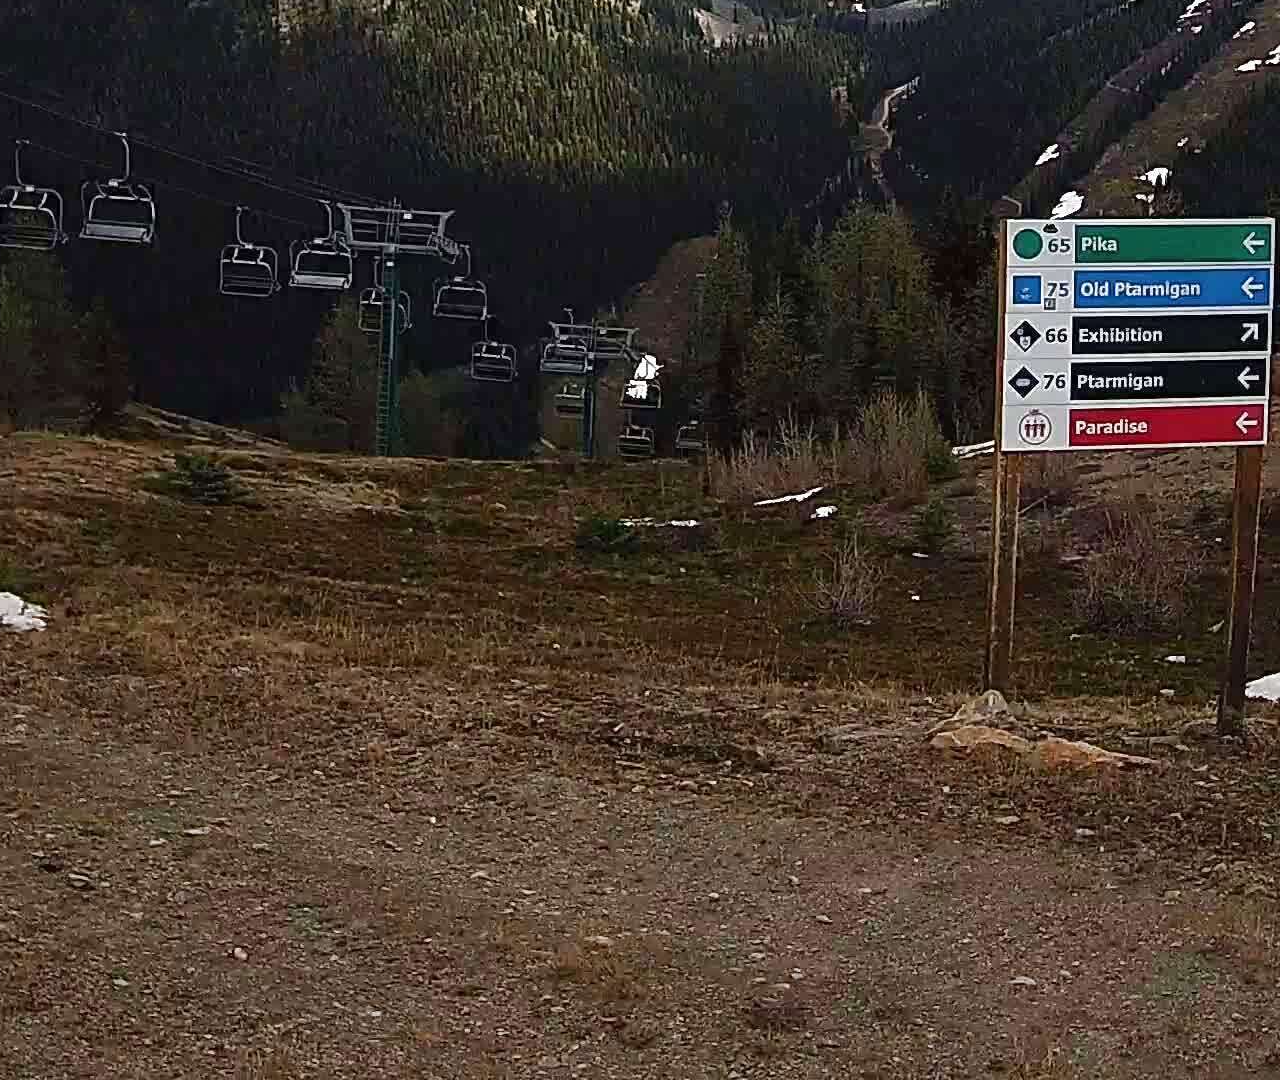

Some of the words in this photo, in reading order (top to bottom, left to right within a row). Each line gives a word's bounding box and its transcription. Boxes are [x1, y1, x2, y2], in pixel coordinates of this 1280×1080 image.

[1047, 238, 1071, 253] 65
[1081, 237, 1118, 252] Pika
[1047, 282, 1069, 297] 75
[1080, 282, 1109, 297] Old
[1114, 281, 1201, 299] Ptarmigan
[1045, 328, 1068, 343] 66
[1078, 327, 1163, 343] Exhibition
[1043, 374, 1066, 390] 76
[1077, 374, 1164, 391] Ptarmigan
[1075, 419, 1148, 435] Paradise
